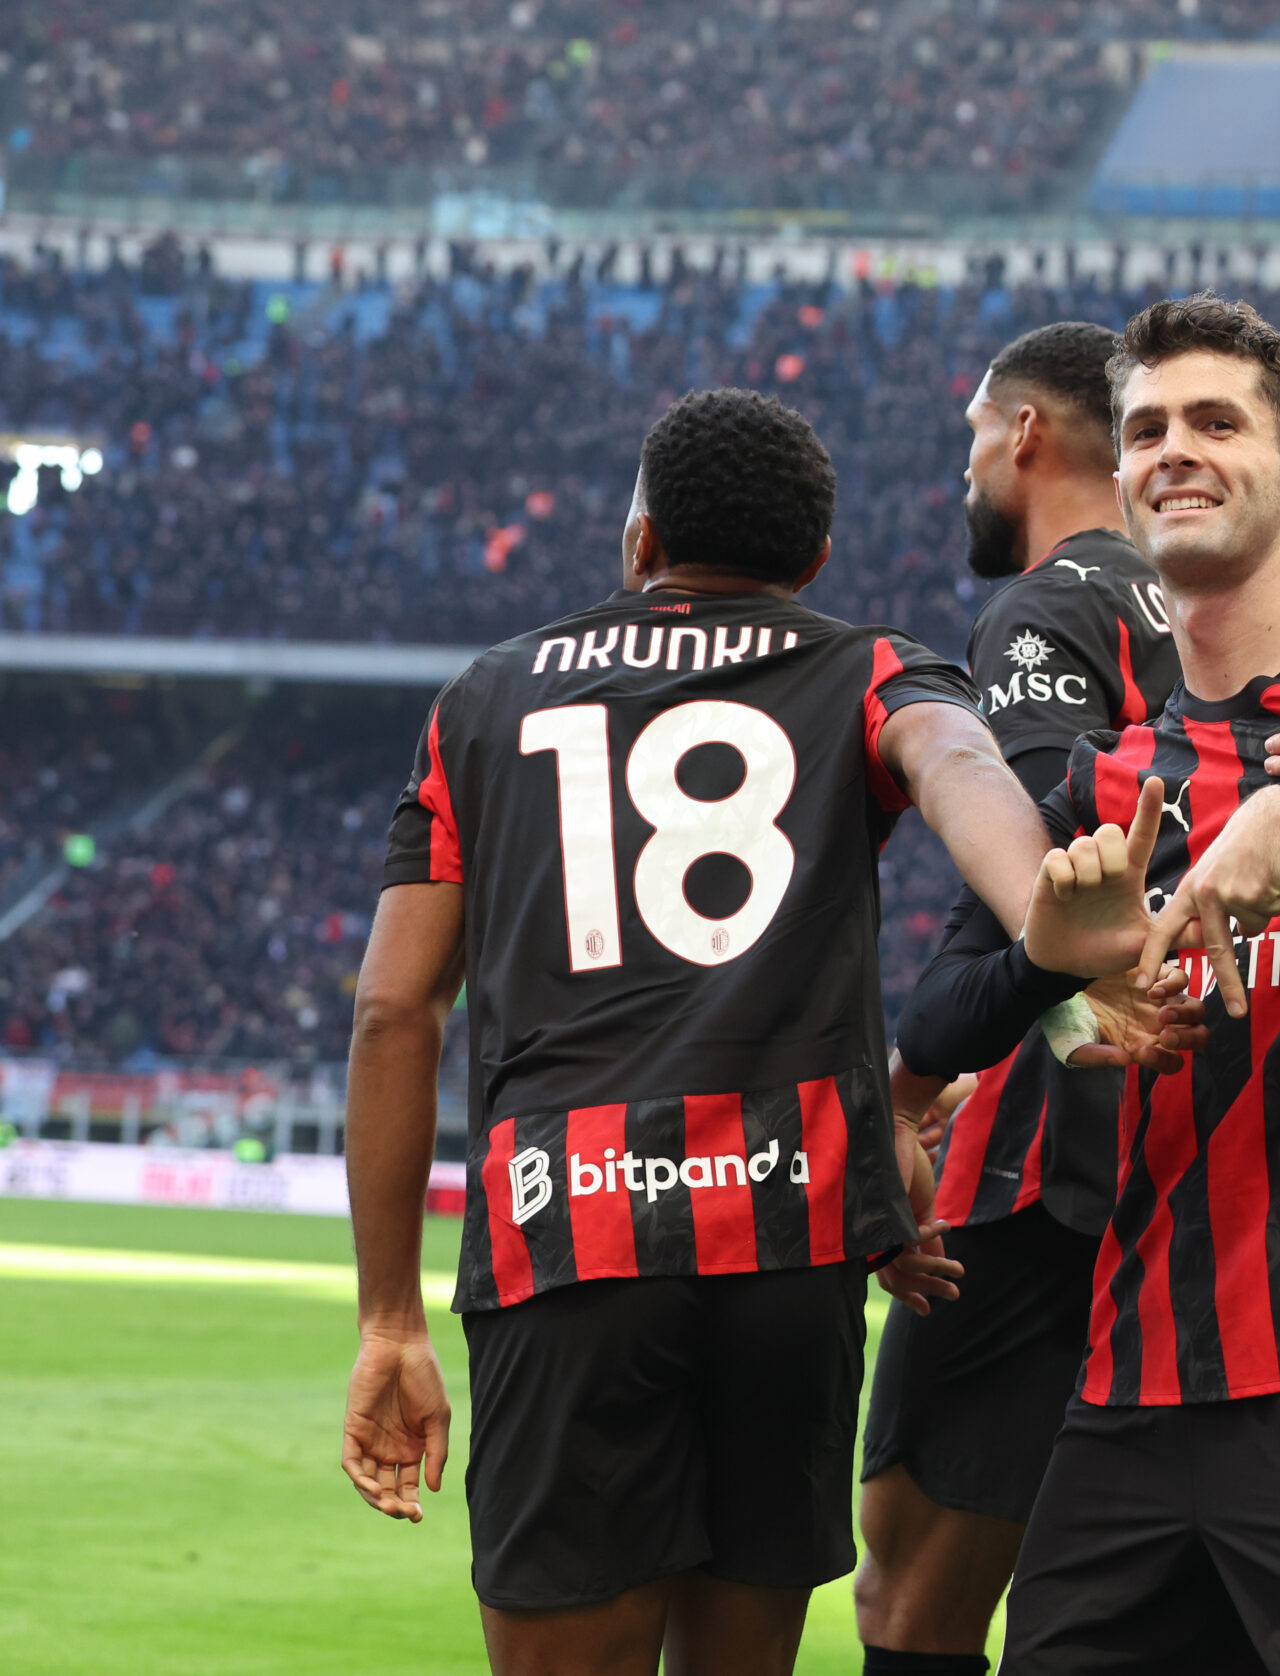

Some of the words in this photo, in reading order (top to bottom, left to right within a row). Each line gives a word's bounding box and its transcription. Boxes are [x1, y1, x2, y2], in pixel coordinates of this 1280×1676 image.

[987, 670, 1088, 716] MSC
[518, 698, 798, 973] 18
[570, 1138, 811, 1204] bitpanda
